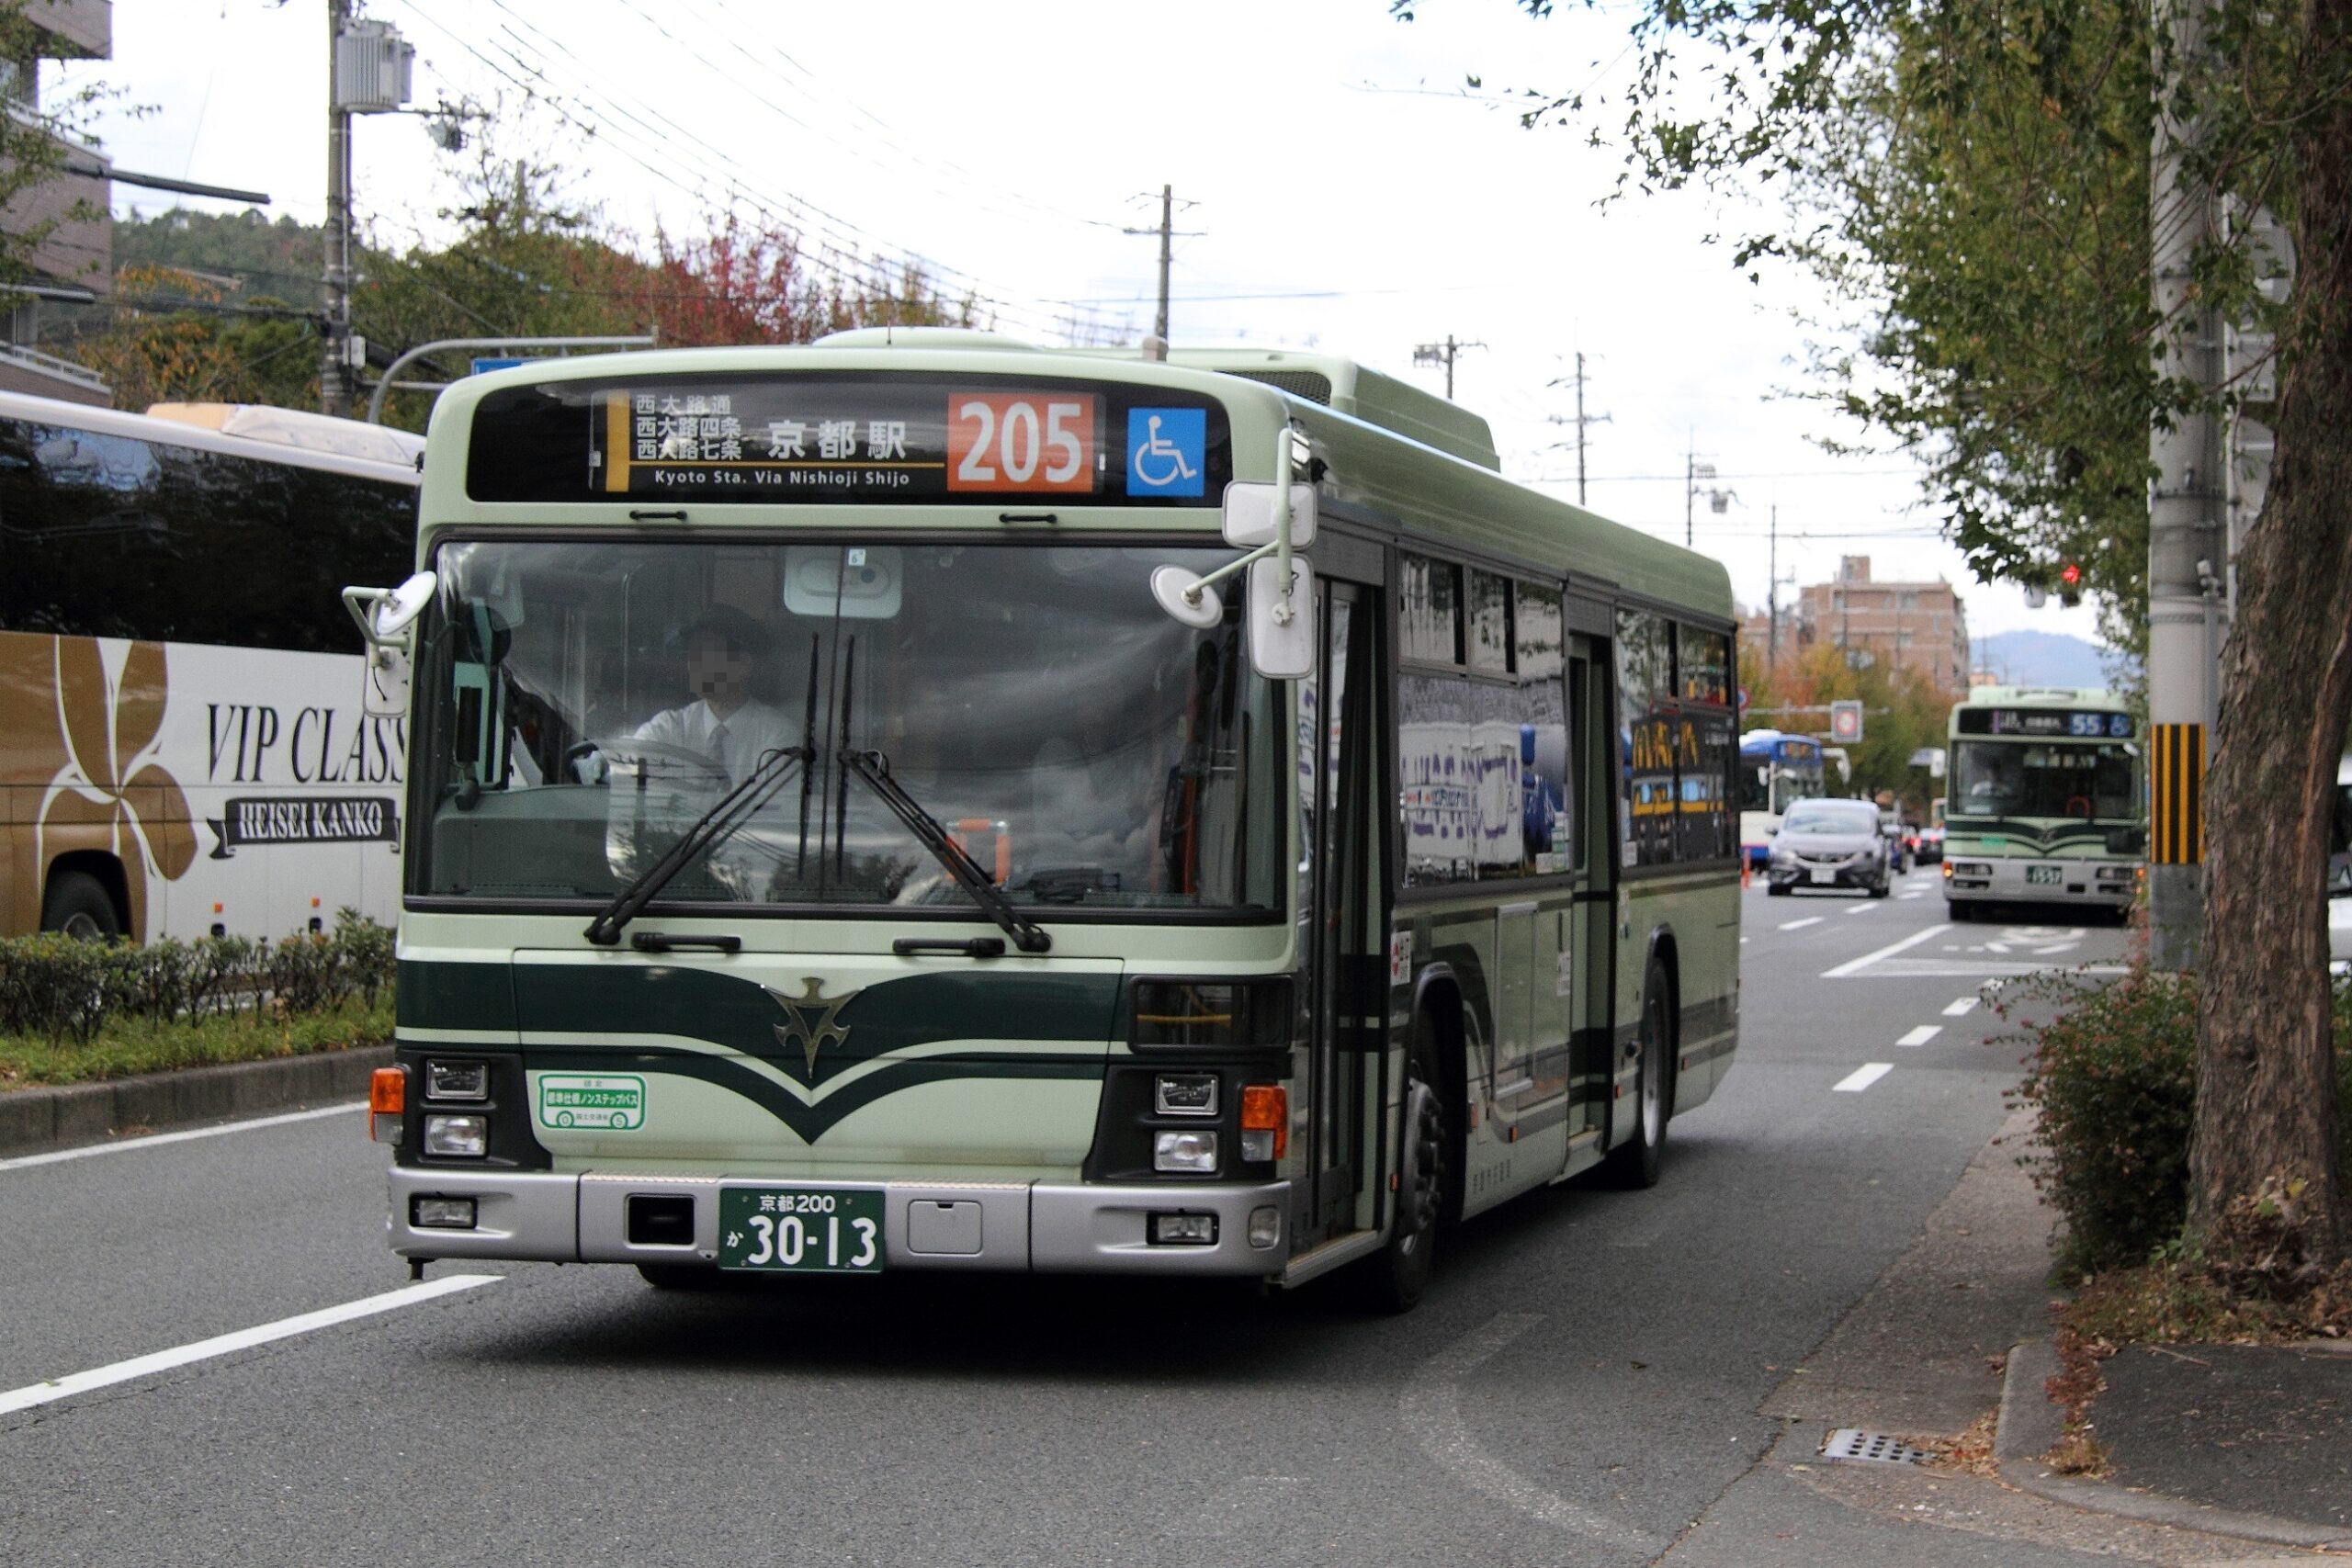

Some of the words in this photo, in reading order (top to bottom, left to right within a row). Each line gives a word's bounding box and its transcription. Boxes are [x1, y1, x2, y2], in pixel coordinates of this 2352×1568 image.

[637, 394, 731, 414] 西大路通
[637, 417, 741, 438] 西大路四条
[637, 439, 741, 460] 西大路七条
[768, 420, 907, 459] 京都駅
[958, 401, 1082, 483] 205
[655, 470, 707, 486] Kyoto
[714, 470, 748, 484] Sta.
[755, 470, 782, 485] Via
[790, 470, 858, 487] Nishioji
[865, 470, 910, 488] Shijo
[2071, 714, 2101, 735] 55
[207, 704, 279, 782] VIP
[240, 802, 310, 839] HEISEI
[313, 801, 383, 838] KANKO
[759, 1195, 836, 1213] 京都200
[726, 1231, 744, 1247] か
[748, 1215, 876, 1267] 30-13
